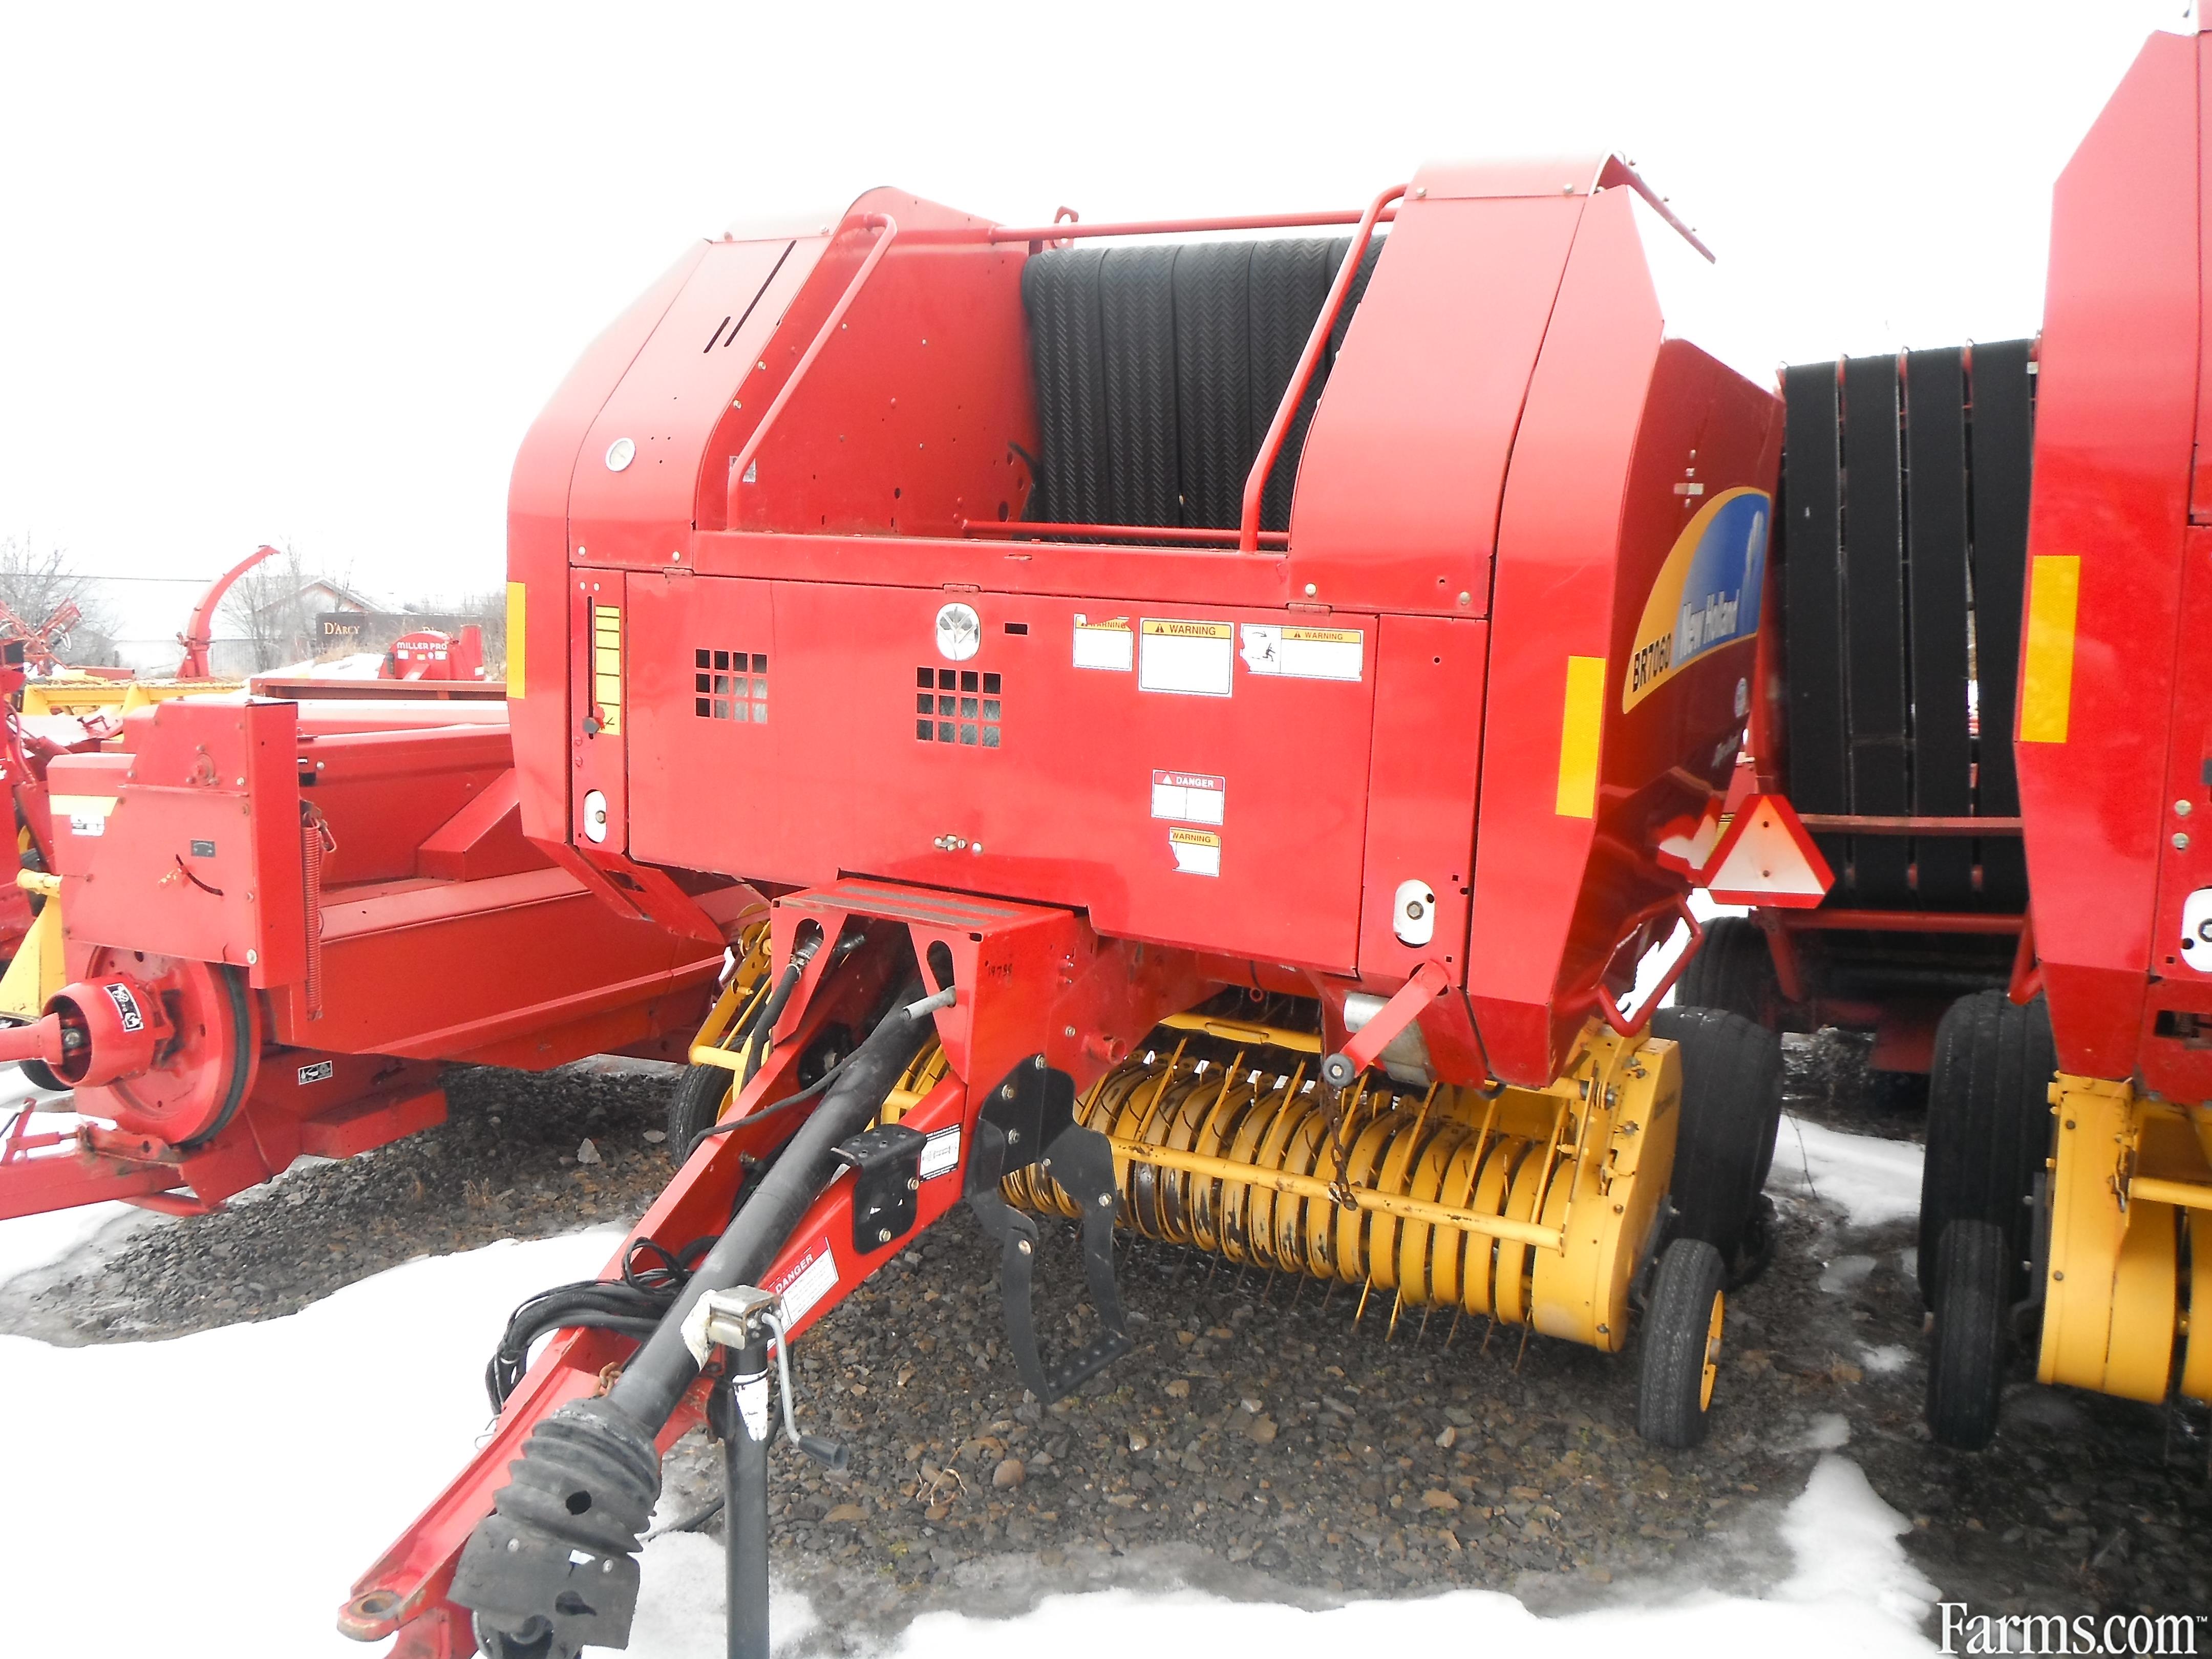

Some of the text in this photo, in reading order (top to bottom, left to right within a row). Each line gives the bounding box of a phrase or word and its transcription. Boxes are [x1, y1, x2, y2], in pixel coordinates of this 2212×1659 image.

[1169, 624, 1216, 635] WARNING
[1305, 632, 1343, 640] WARNING
[397, 642, 448, 650] MILLER PRO
[1632, 632, 1671, 692] BR7060
[1176, 776, 1215, 788] DANGER
[775, 1253, 814, 1294] DANGER
